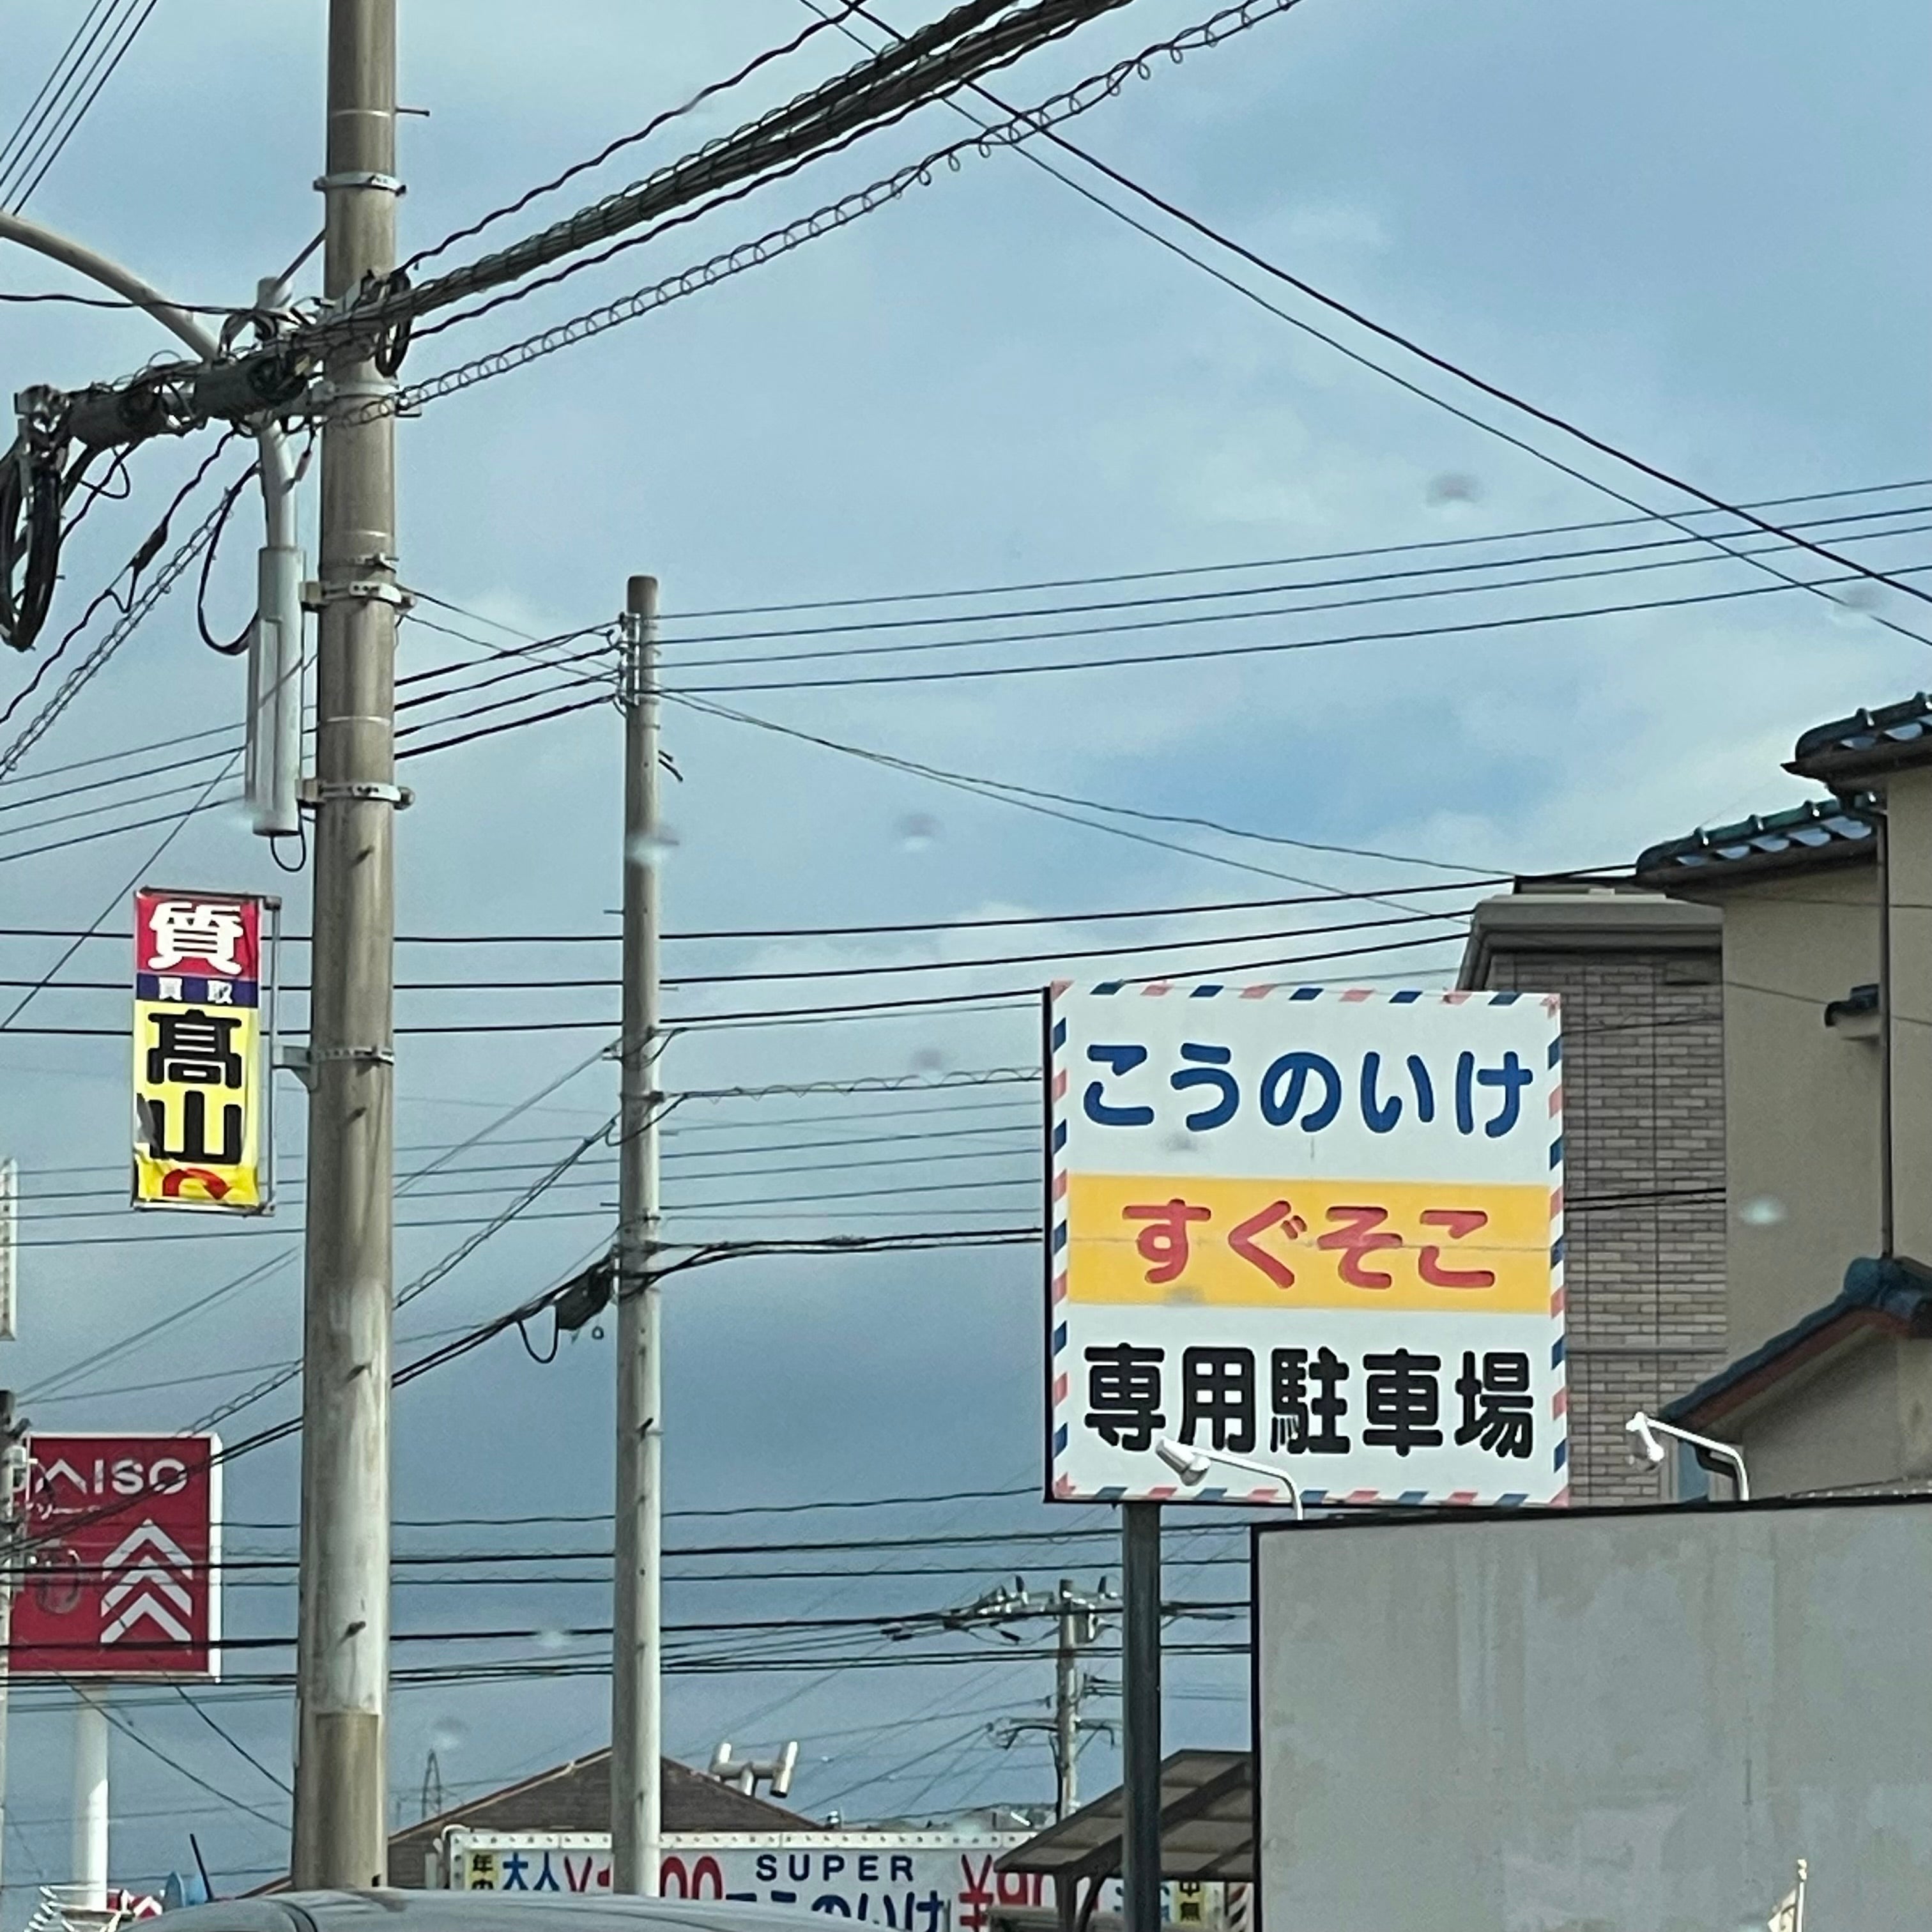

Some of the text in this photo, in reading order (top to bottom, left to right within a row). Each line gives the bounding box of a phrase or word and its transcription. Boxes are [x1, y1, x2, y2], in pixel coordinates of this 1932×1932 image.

[148, 901, 243, 974] 質
[1084, 1042, 1533, 1138] こうのいけ
[1122, 1199, 1496, 1290] すぐそこ
[1084, 1343, 1534, 1459] 専用駐車場
[756, 1853, 914, 1882] SUPER
